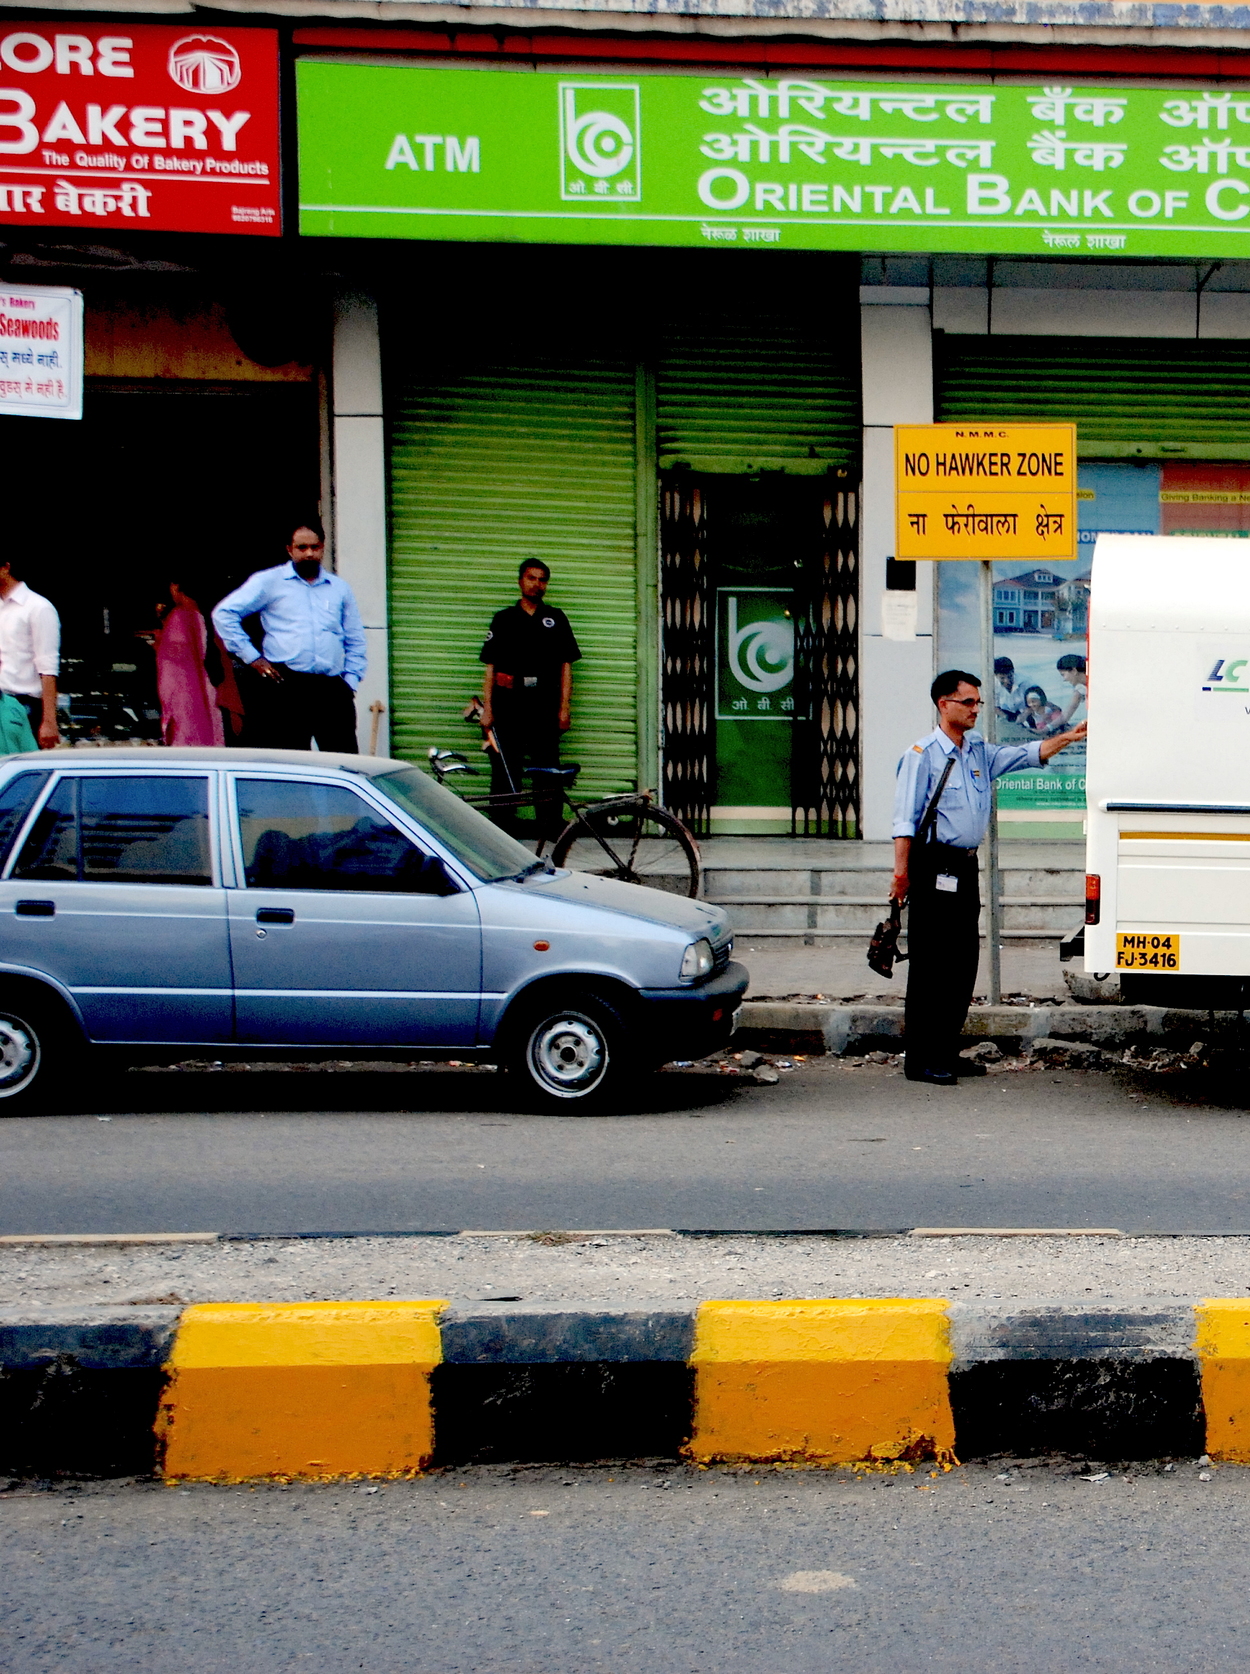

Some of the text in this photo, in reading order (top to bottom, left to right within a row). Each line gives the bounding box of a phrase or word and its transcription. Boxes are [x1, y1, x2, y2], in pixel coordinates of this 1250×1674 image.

[0, 31, 134, 77] ORE
[699, 79, 996, 124] ओरियन्टल
[42, 150, 269, 175] The Quality Of Bakery Products
[385, 134, 480, 173] ATM
[699, 123, 996, 169] ओरियन्टल
[1026, 130, 1128, 171] बैंक
[0, 179, 152, 217] ार बेकरी
[697, 167, 951, 216] ORIENTAL
[965, 173, 1115, 219] BANK
[1127, 190, 1189, 218] OF
[742, 228, 781, 243] शाखा
[1086, 232, 1127, 250] शाखा
[905, 452, 1064, 477] NO HAWKER ZONE
[1161, 493, 1189, 503] Giving
[1192, 494, 1227, 504] Banking
[907, 513, 928, 536] ना
[943, 504, 1018, 536] फेरीवाला
[1035, 504, 1065, 541] क्षेत्र
[1037, 778, 1062, 790] Bank
[1066, 778, 1076, 790] of
